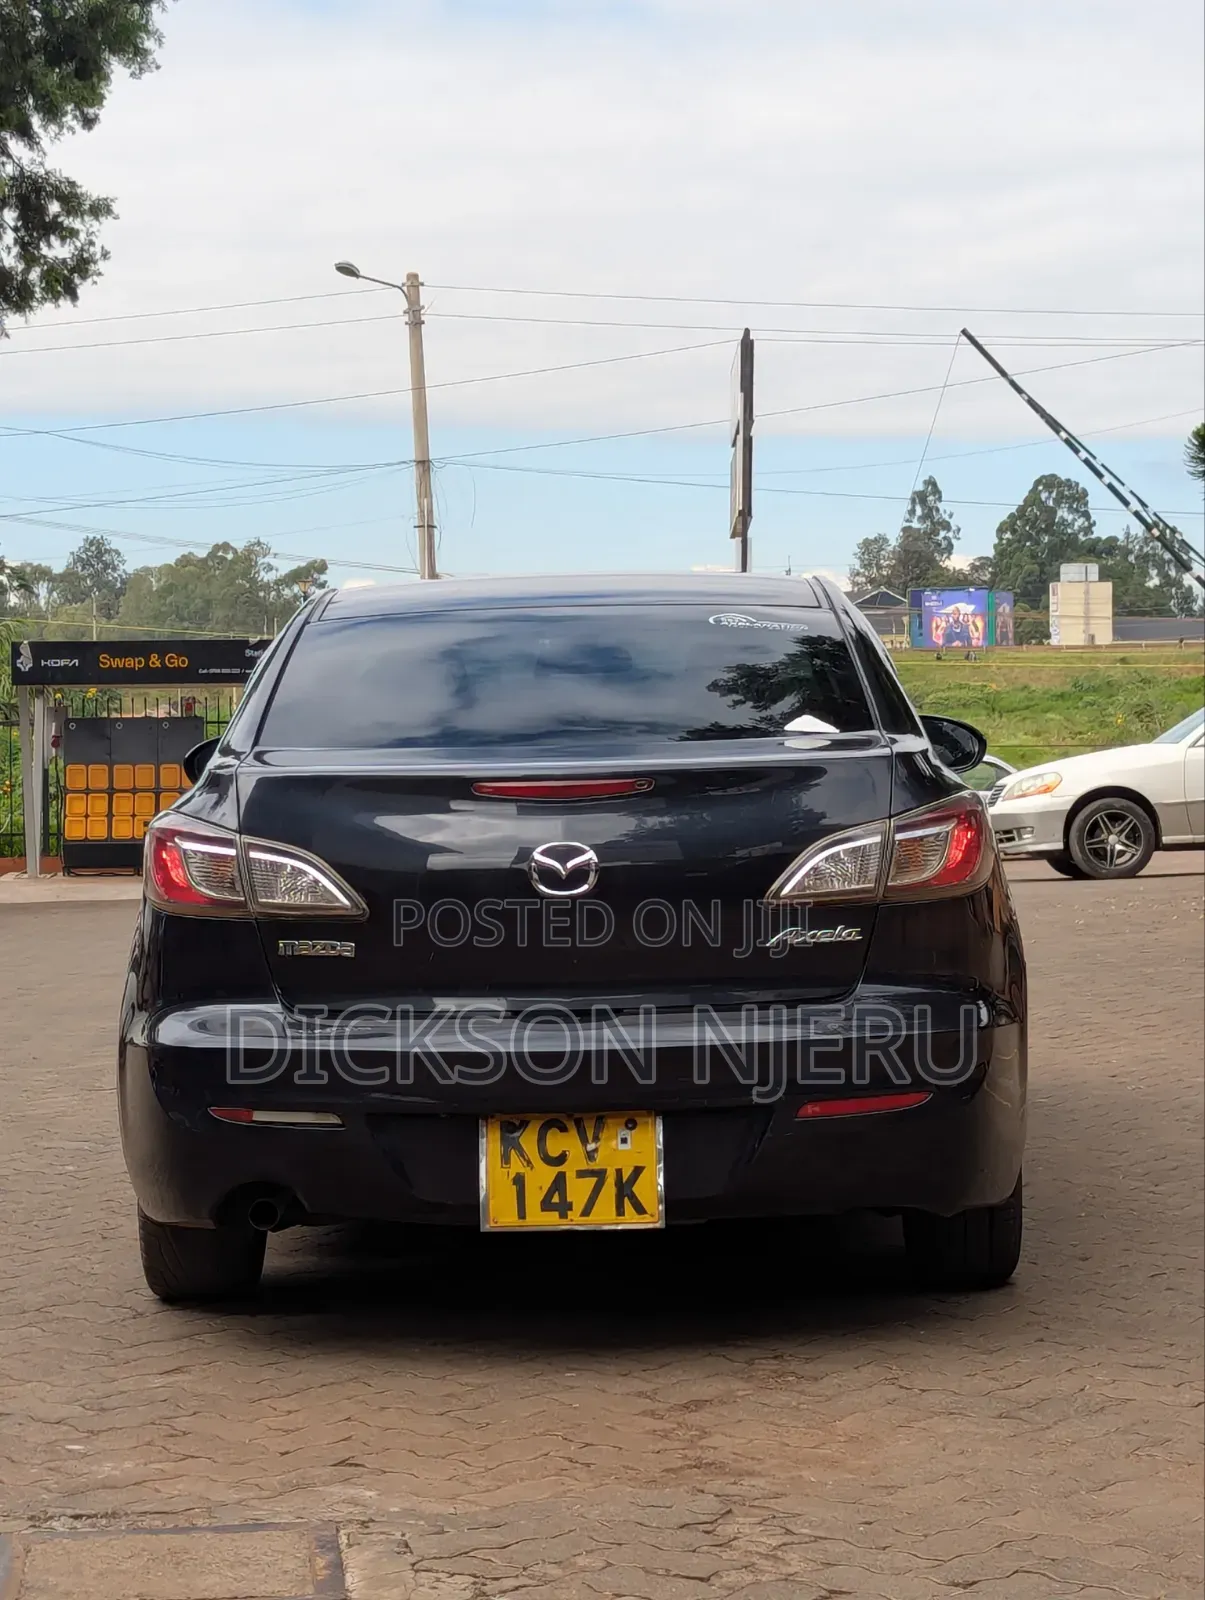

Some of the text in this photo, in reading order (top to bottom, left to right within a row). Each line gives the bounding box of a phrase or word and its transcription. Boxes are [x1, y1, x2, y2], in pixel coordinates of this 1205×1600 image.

[41, 658, 79, 667] KOFA
[99, 653, 189, 671] Swap & Go
[766, 925, 863, 946] Axela
[500, 1115, 606, 1169] KCV
[511, 1166, 648, 1220] 147K
